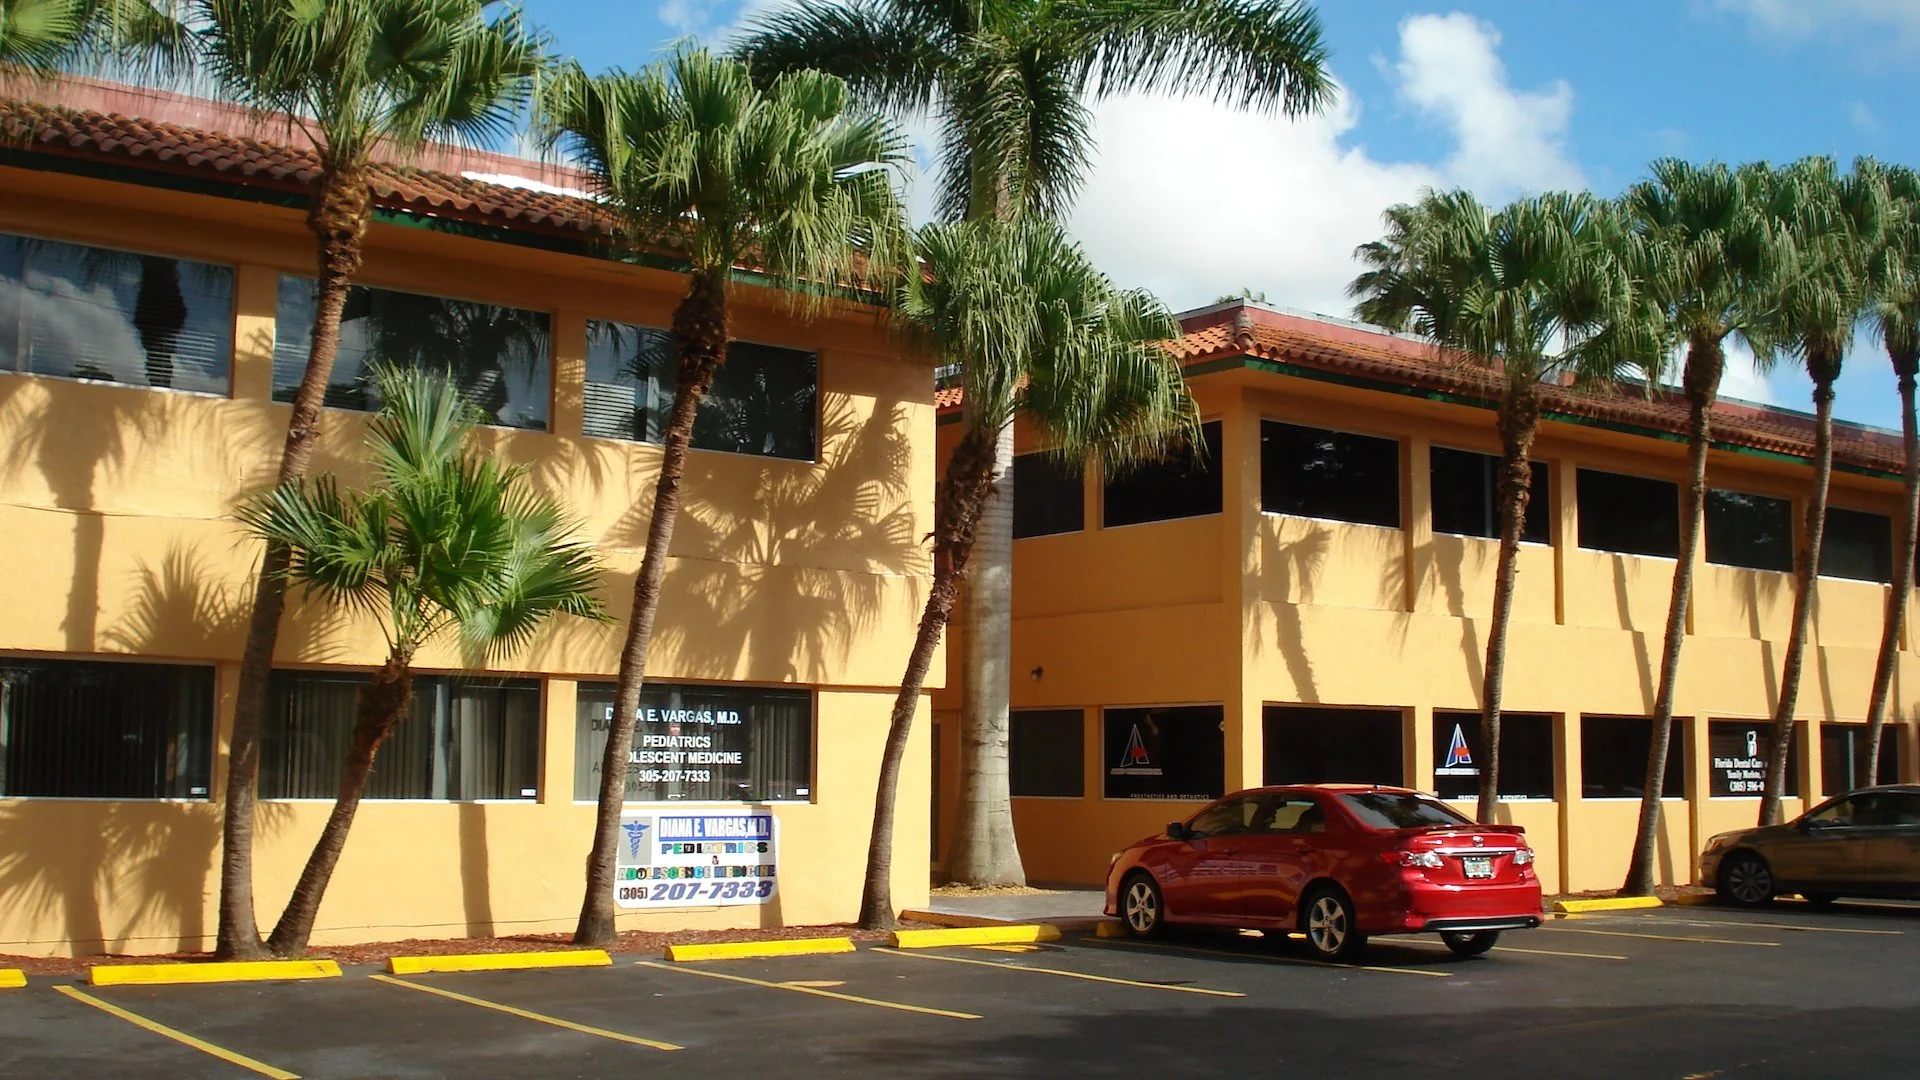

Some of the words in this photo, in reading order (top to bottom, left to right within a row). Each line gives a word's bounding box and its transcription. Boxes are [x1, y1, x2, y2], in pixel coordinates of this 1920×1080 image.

[646, 708, 659, 722] E.
[660, 709, 715, 726] VARGAS,
[716, 710, 742, 725] M.D.
[643, 734, 711, 748] PEDIATRICS
[687, 751, 742, 765] MEDICINE
[639, 769, 711, 783] 305-207-7333
[659, 817, 693, 838] DIANA
[661, 841, 768, 855] PEDIATRICS
[712, 855, 719, 865] &
[617, 866, 712, 880] ADOLESCENCE
[713, 864, 776, 878] MEDICINE
[650, 880, 774, 901] 207-7333
